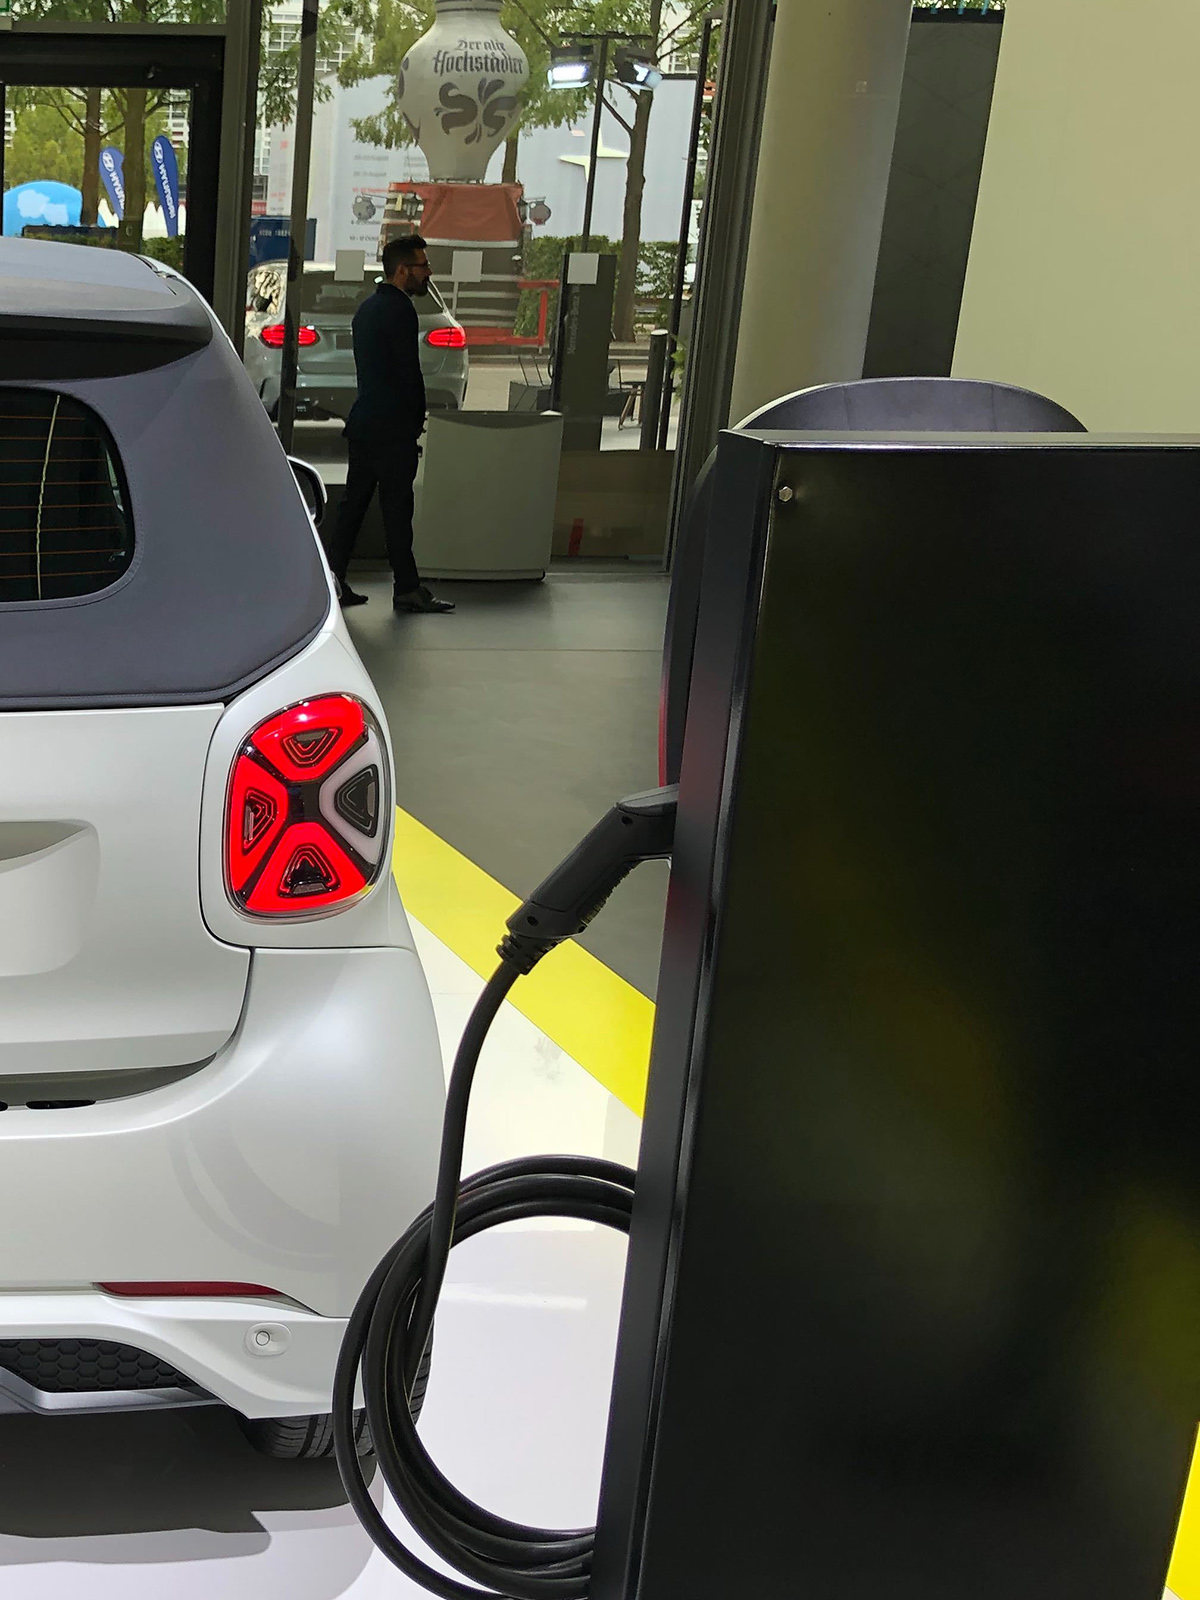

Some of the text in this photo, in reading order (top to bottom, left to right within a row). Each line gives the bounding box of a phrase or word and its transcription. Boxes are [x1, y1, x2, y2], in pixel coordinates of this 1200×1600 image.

[455, 40, 481, 51] Der
[109, 170, 125, 210] HYUN
[159, 162, 176, 219] HYUNDAI
